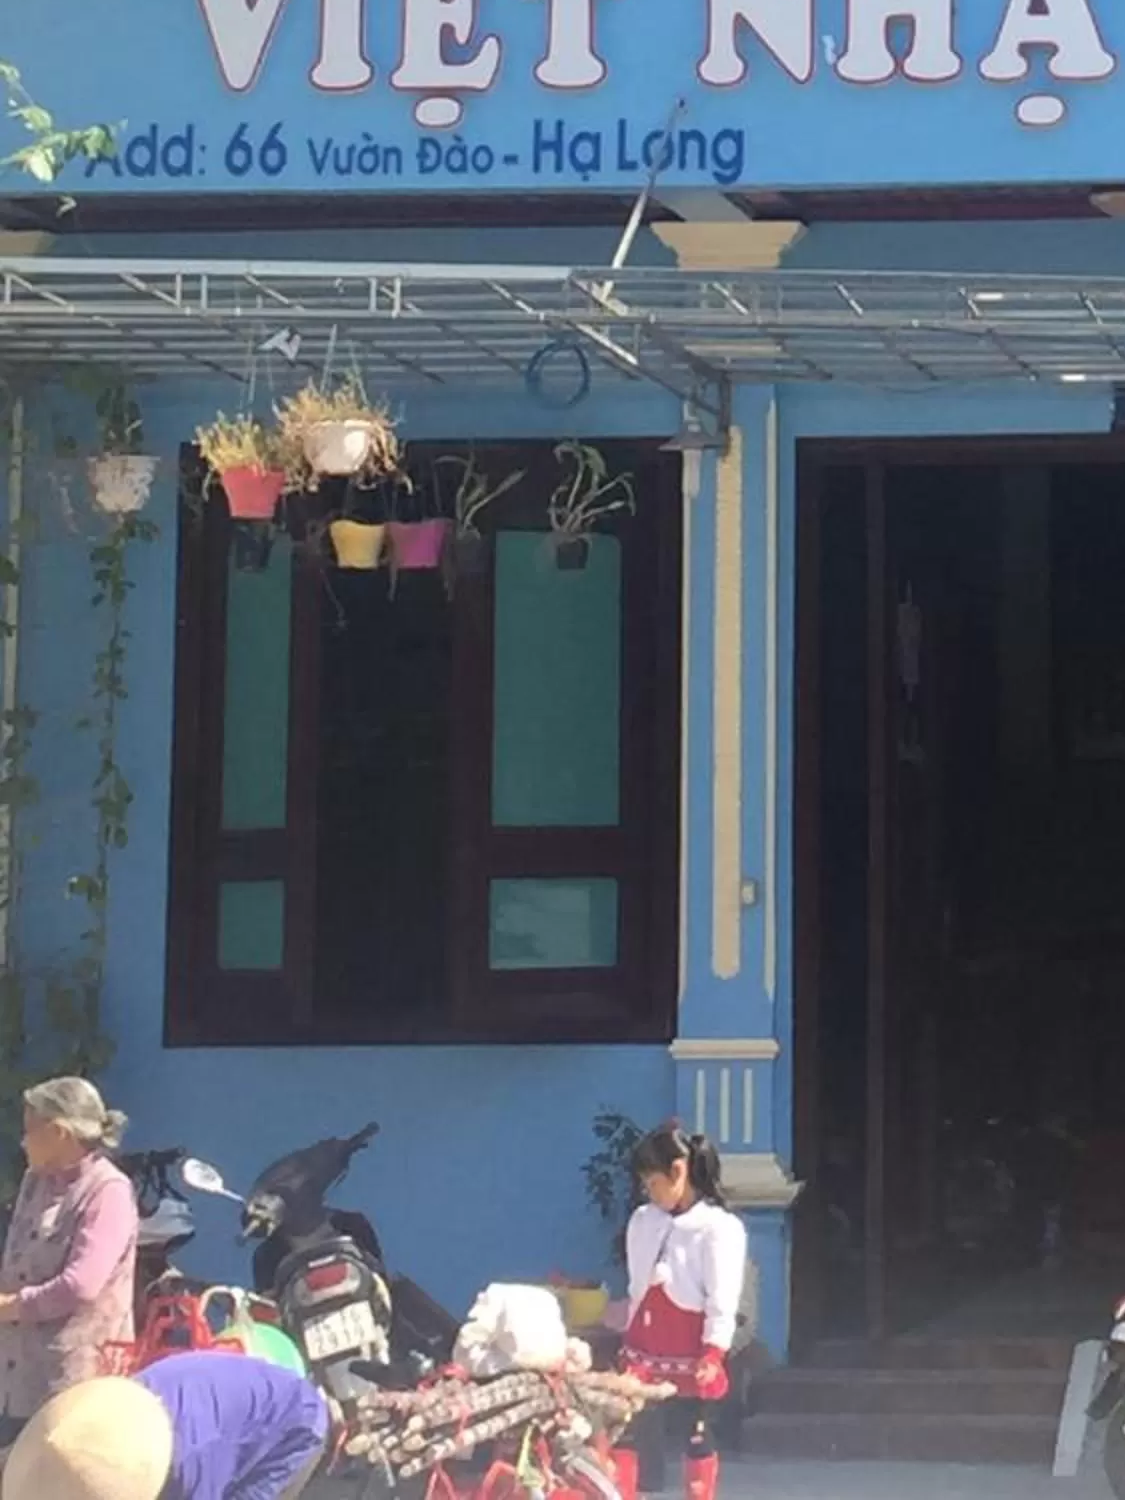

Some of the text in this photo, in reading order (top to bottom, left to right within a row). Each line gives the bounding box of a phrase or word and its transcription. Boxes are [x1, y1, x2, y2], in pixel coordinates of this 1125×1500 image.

[224, 121, 288, 177] 66
[306, 132, 402, 177] Vườn
[532, 118, 601, 183] Hạ
[617, 118, 746, 186] Long
